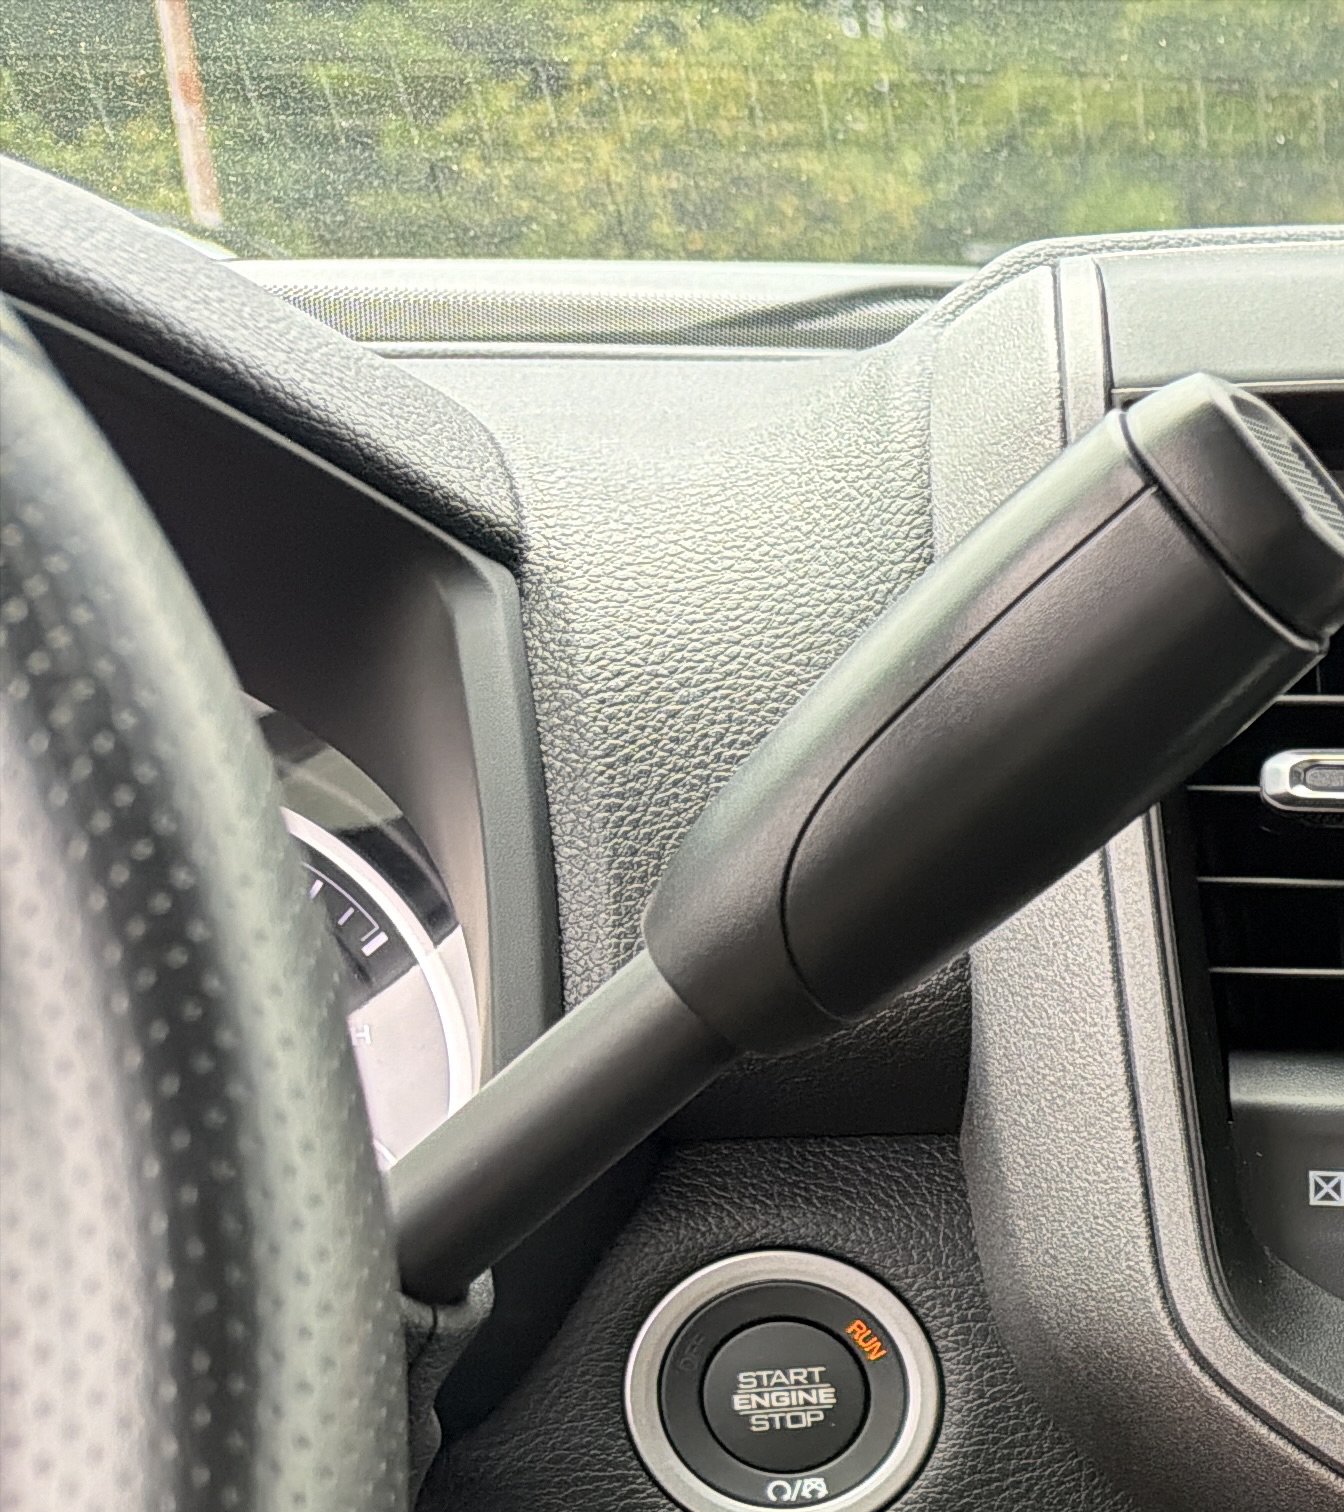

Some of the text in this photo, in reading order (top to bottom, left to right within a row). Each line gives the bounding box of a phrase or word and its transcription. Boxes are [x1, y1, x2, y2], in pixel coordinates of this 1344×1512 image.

[846, 1319, 886, 1361] RUN
[736, 1366, 826, 1389] START
[732, 1388, 837, 1411] ENGINE
[749, 1411, 824, 1431] STOP
